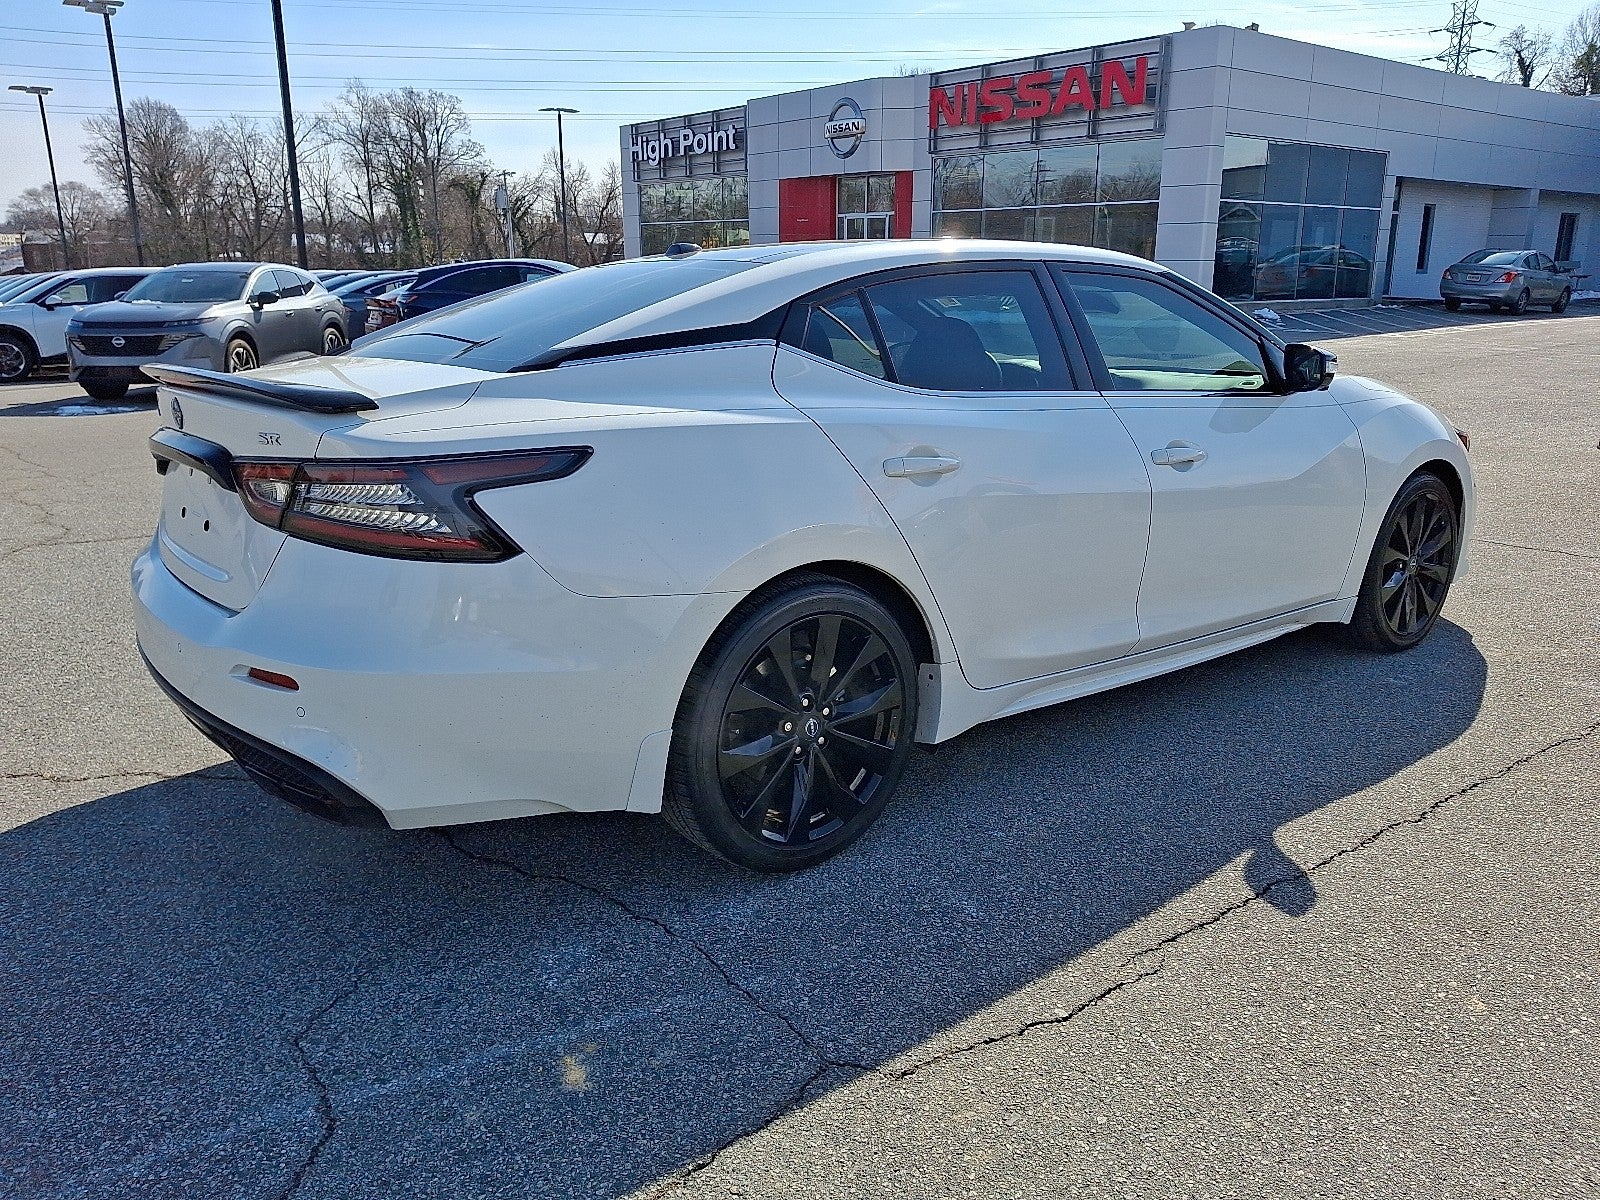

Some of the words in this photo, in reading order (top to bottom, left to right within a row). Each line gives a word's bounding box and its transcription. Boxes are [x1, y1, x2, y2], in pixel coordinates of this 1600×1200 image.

[929, 56, 1148, 130] NISSAN
[825, 121, 860, 135] NISSAN
[629, 132, 673, 166] High
[680, 124, 736, 156] Point
[258, 431, 281, 446] SR
